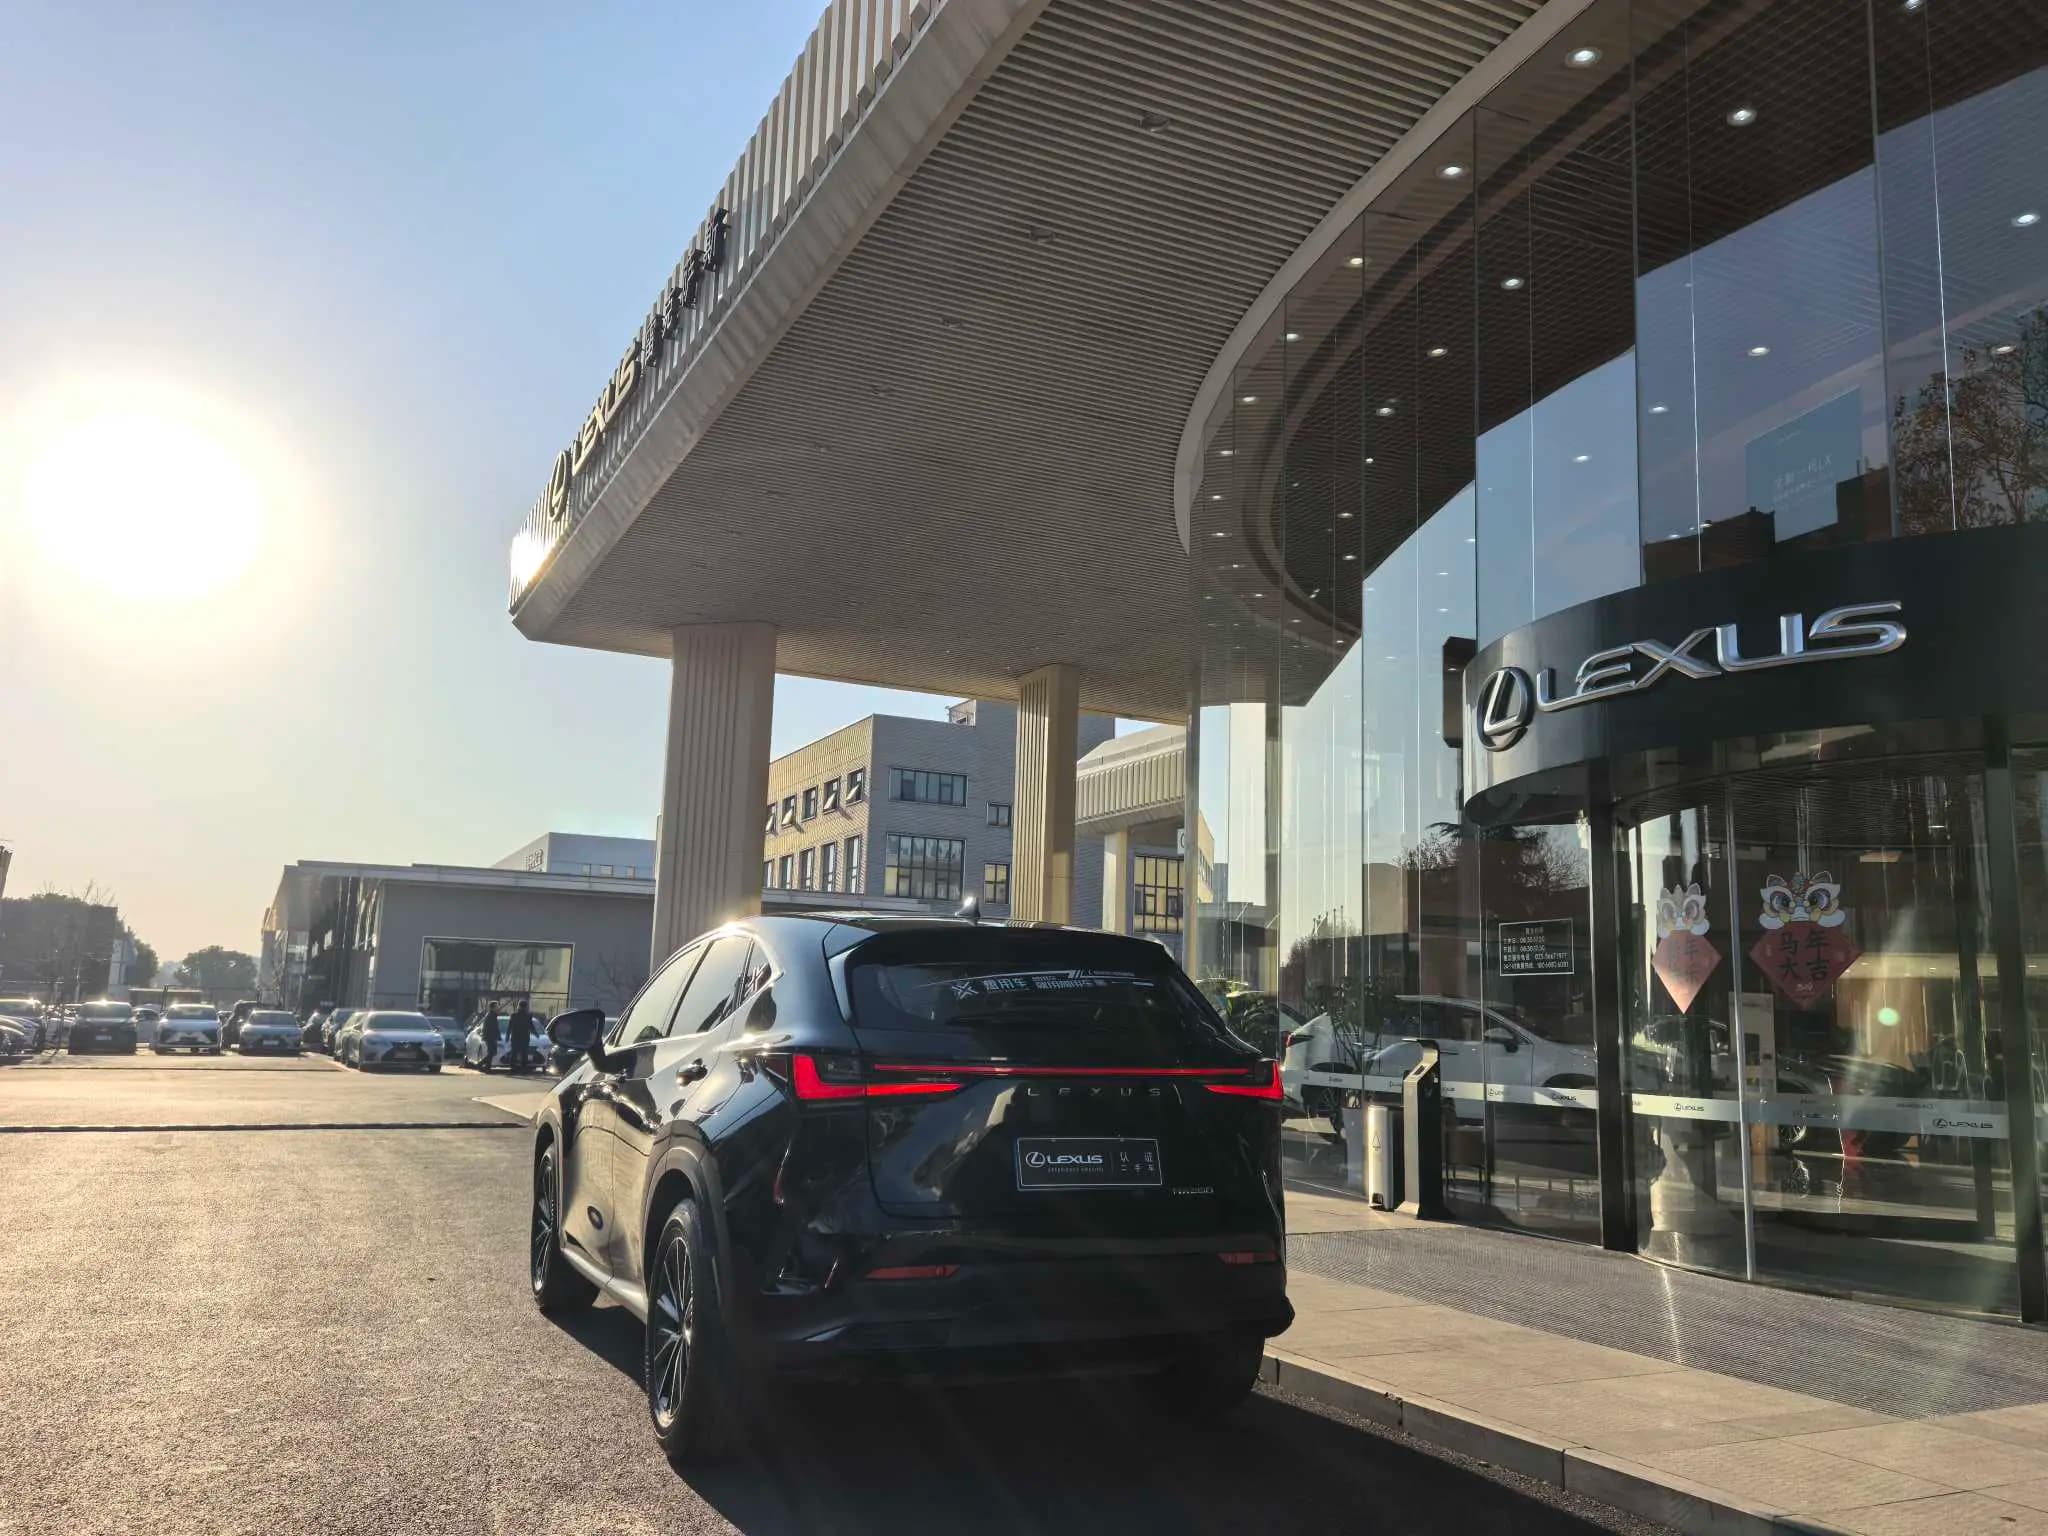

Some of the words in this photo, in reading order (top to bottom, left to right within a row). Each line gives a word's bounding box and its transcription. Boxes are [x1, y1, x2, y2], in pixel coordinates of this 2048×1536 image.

[572, 338, 642, 476] LEXUS
[1536, 600, 1907, 712] LEXUS
[1027, 1087, 1161, 1097] LEXUS
[1047, 1154, 1104, 1164] LEXUS
